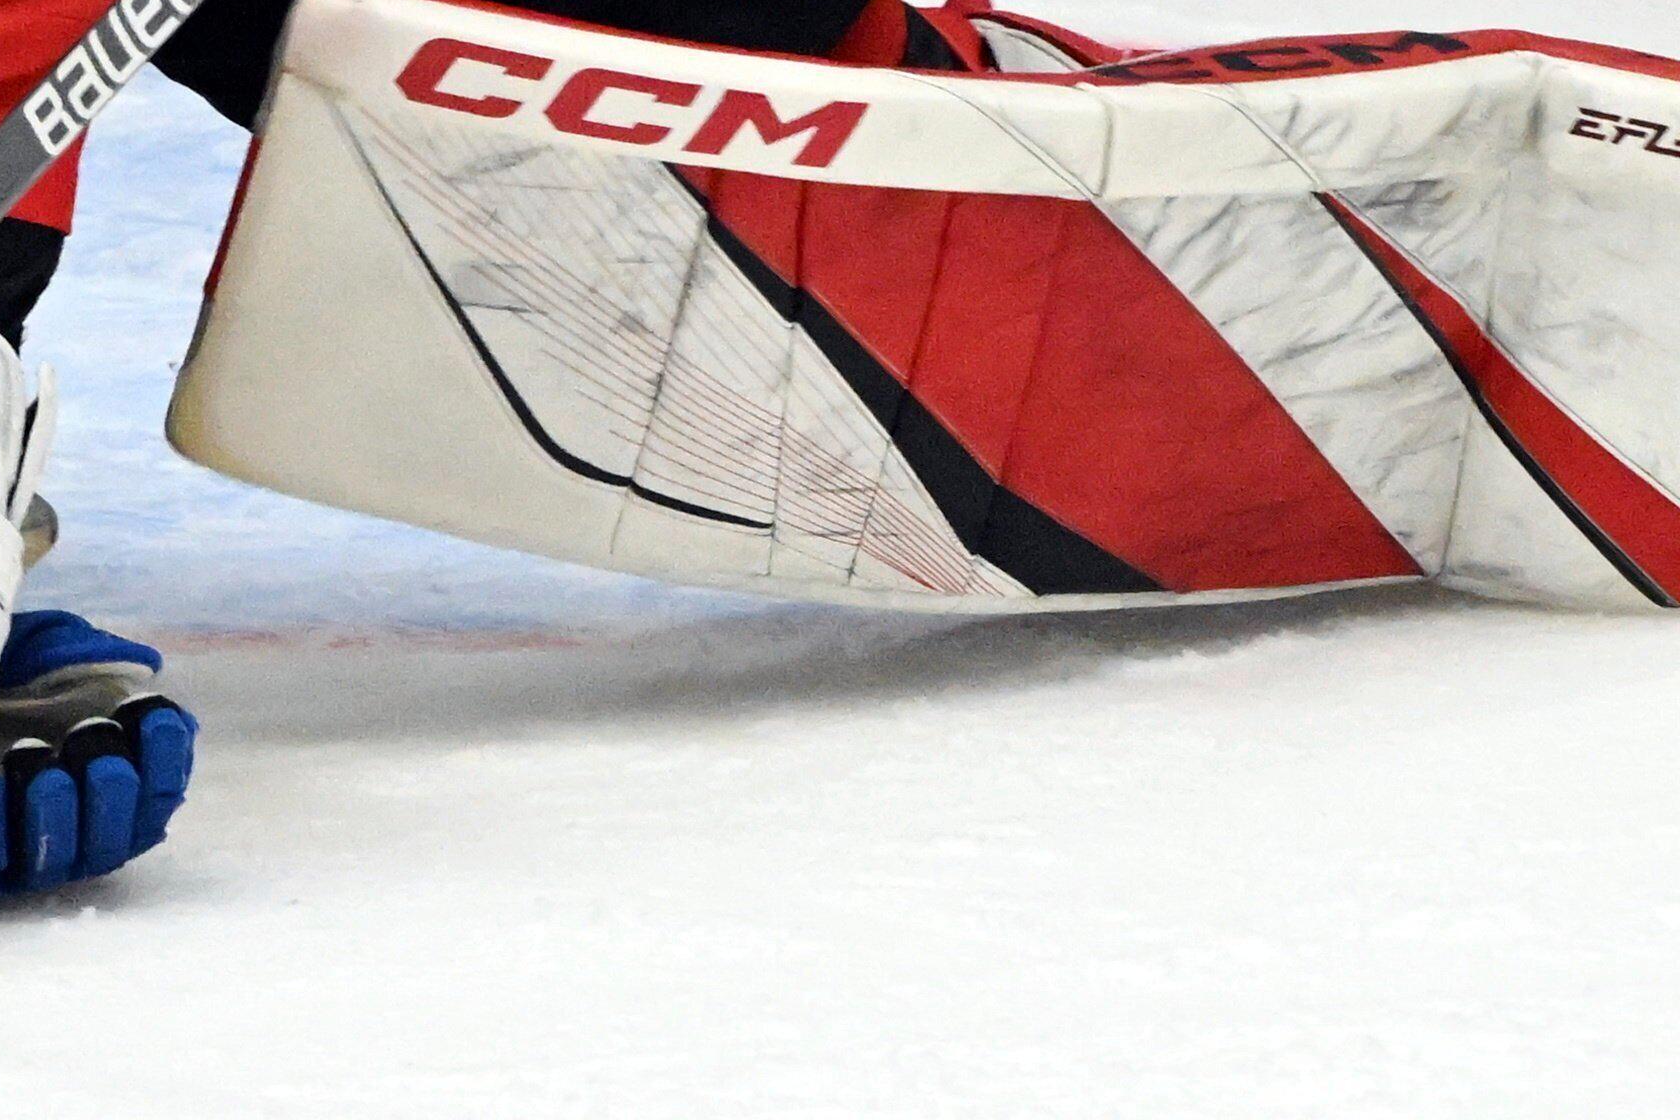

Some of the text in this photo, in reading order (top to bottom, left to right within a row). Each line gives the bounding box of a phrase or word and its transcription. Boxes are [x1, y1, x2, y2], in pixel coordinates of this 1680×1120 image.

[1094, 31, 1470, 80] CCM
[395, 37, 870, 168] CCM
[1567, 106, 1680, 159] EFL
